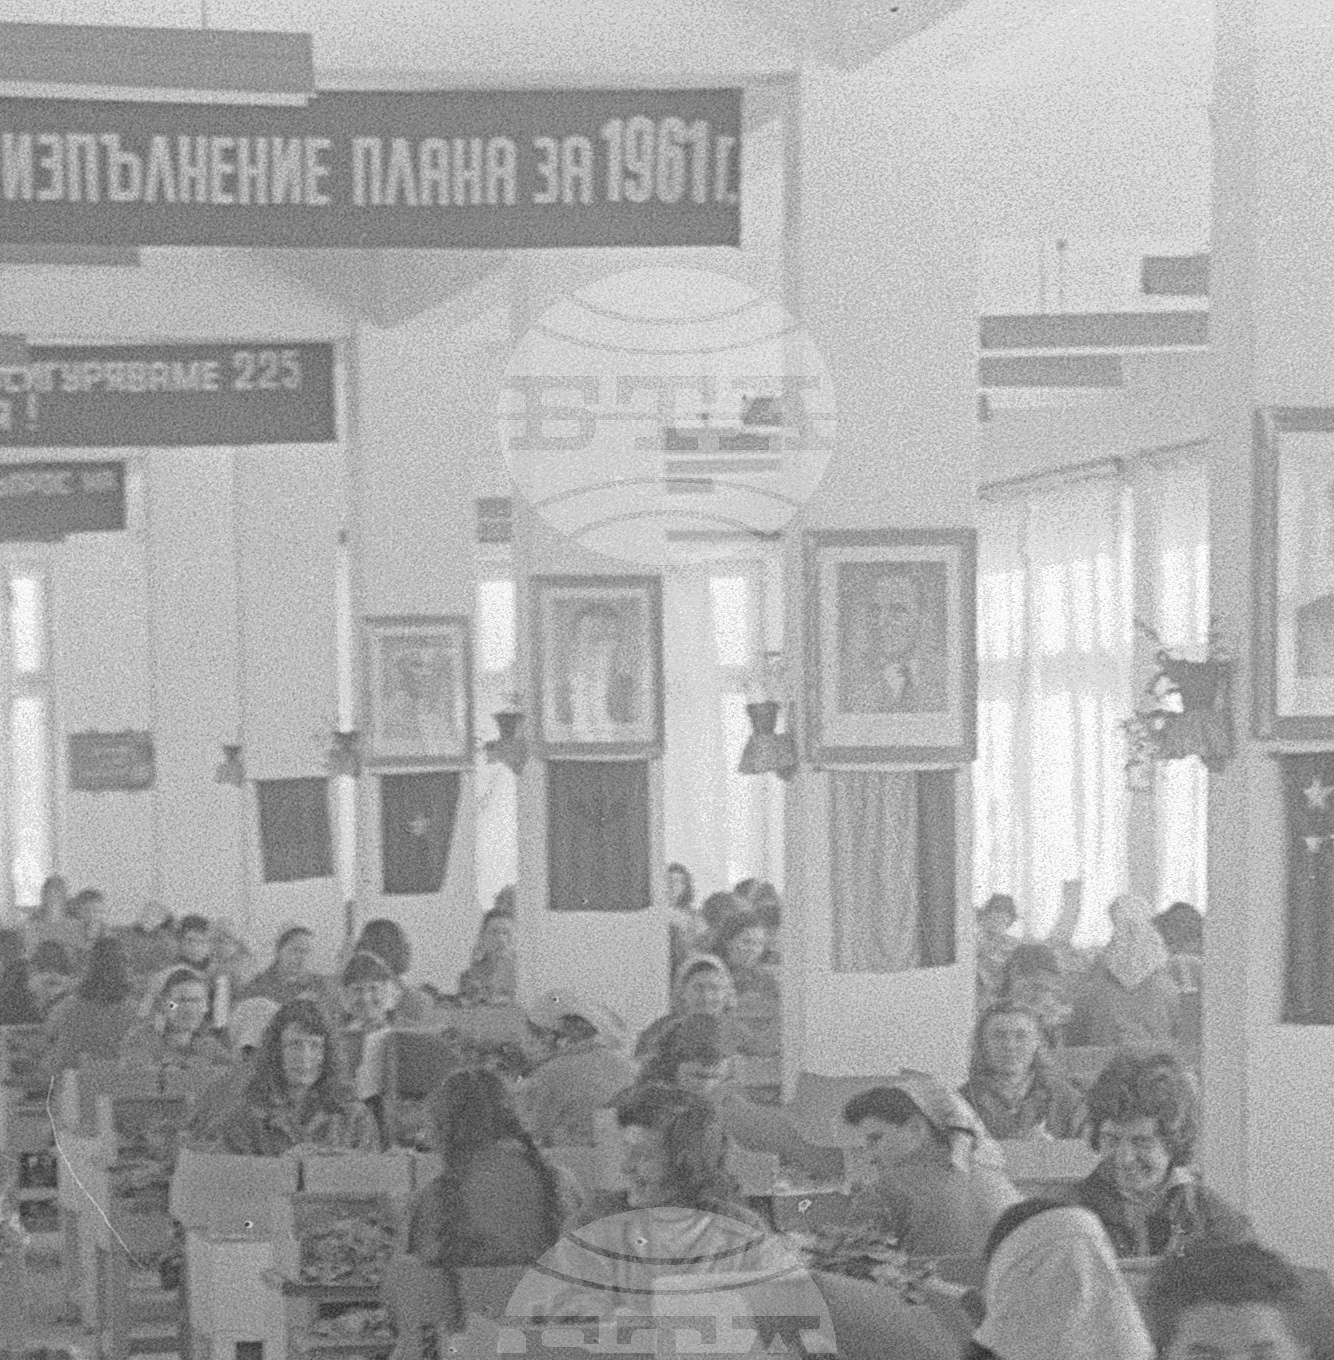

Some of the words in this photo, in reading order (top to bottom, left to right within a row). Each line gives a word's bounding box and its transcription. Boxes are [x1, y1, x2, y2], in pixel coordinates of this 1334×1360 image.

[0, 132, 331, 205] ИЗПЪЛНЕНИЕ
[351, 136, 517, 206] ПЛАНА
[532, 136, 594, 204] ЗА
[233, 348, 305, 391] 225
